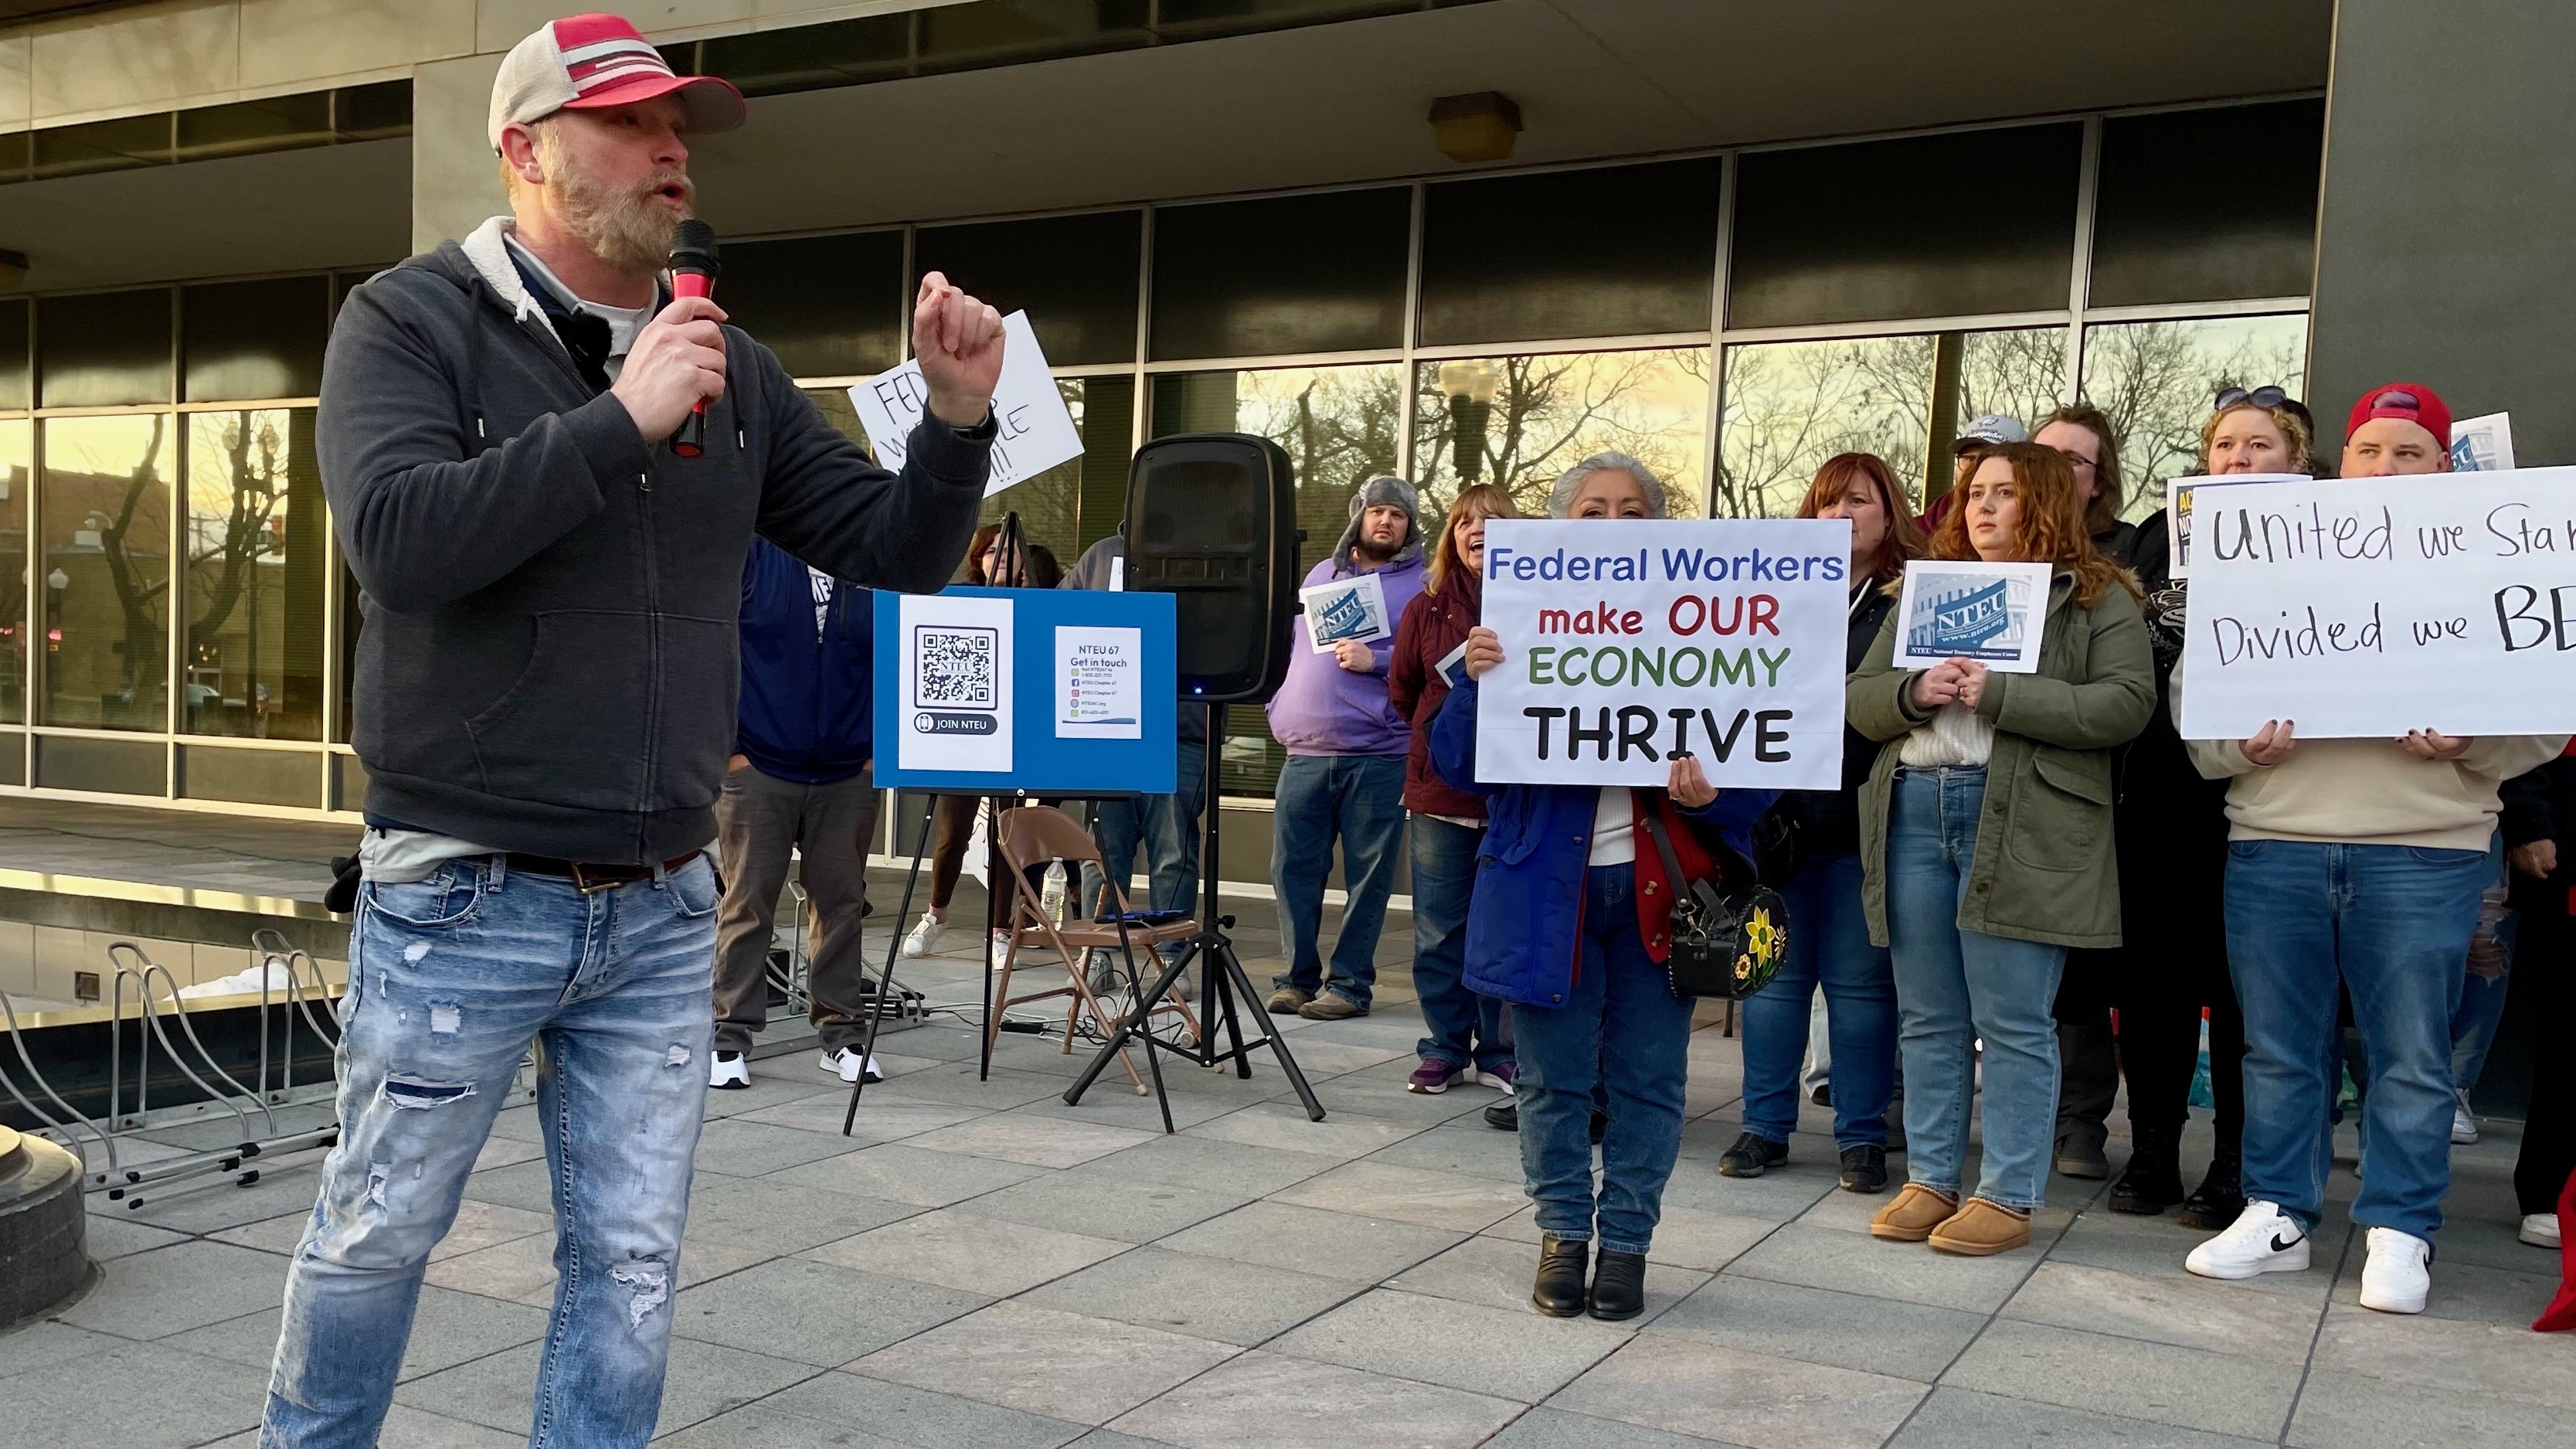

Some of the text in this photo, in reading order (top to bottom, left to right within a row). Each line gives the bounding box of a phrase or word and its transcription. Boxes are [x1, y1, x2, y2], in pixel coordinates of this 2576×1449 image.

[2214, 501, 2393, 563] United
[2418, 524, 2468, 560] we
[1489, 548, 1844, 582] Federal Workers
[1538, 594, 1780, 637] make OUR
[1936, 587, 2007, 631] NTEU
[1079, 645, 1120, 655] NTEU 67
[2212, 602, 2384, 666] Divided
[2413, 615, 2469, 646] we
[940, 662, 973, 672] NTEU
[1070, 657, 1127, 668] Get in touch
[1528, 646, 1792, 687] ECONOMY
[936, 719, 987, 730] JOIN NTEU
[1523, 705, 1794, 764] THRIVE
